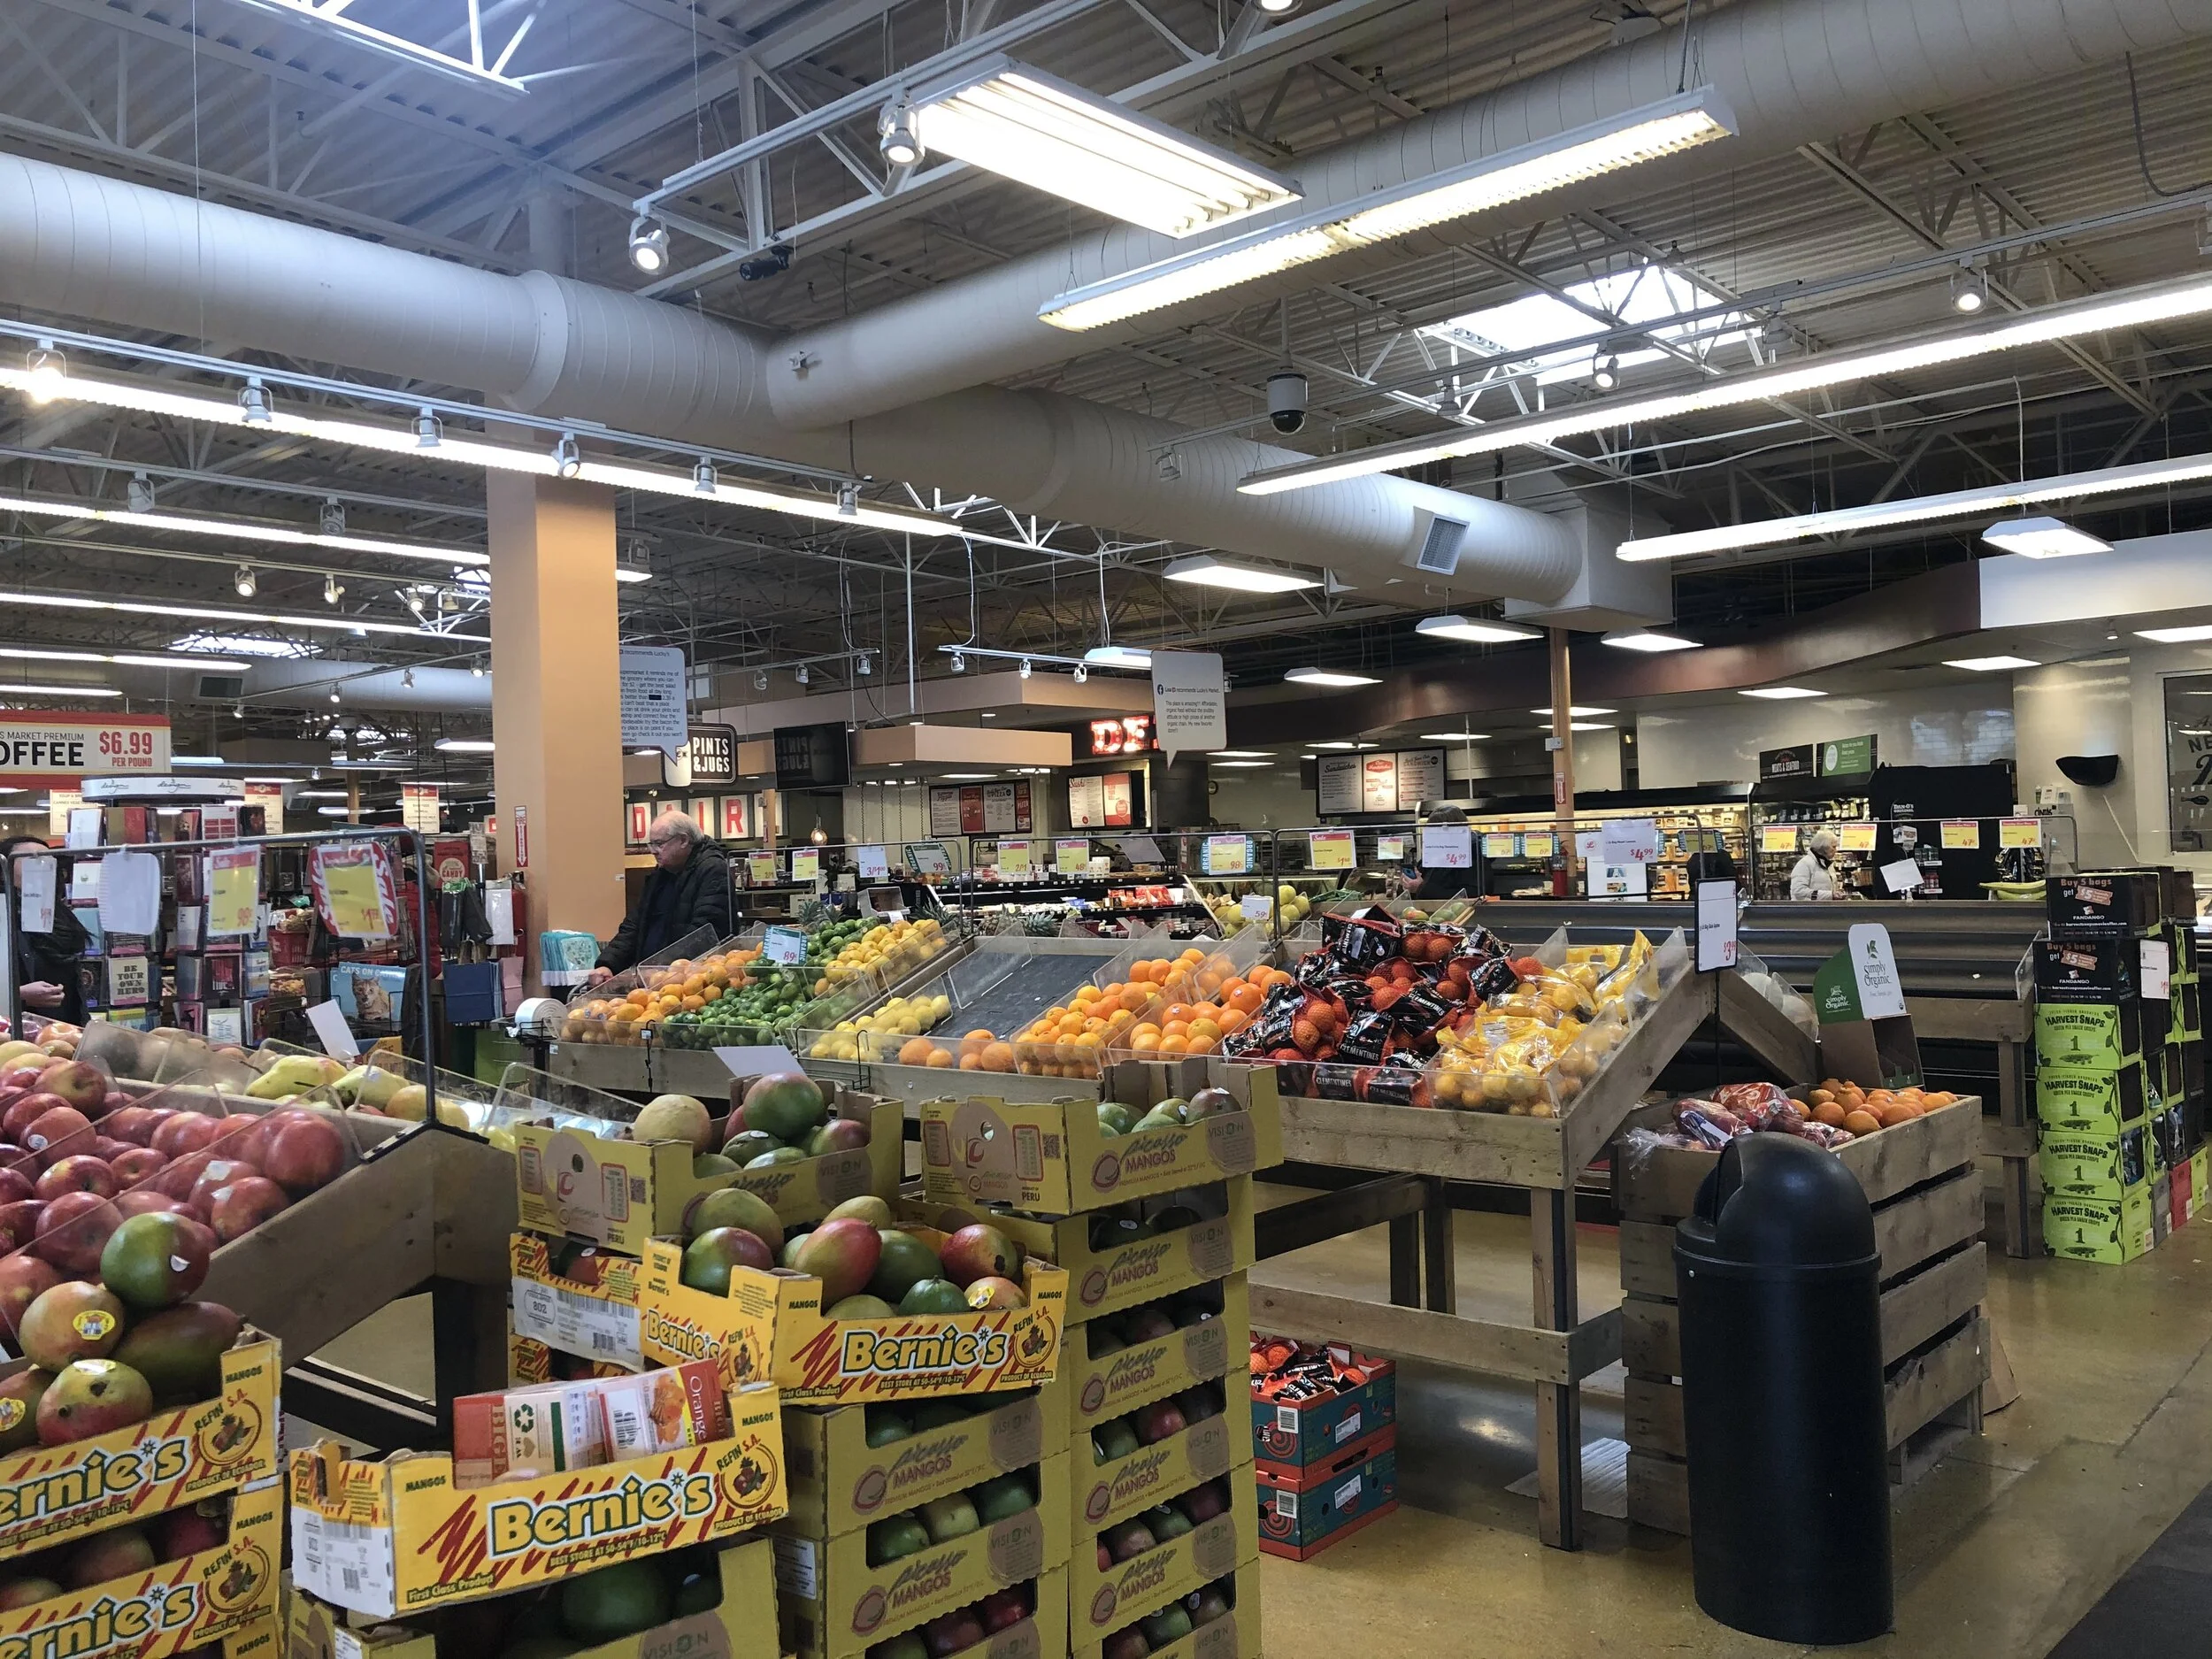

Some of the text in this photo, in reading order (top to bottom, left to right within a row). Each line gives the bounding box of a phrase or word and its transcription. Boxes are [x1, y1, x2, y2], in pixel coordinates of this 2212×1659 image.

[44, 732, 84, 741] PREMIUM
[99, 731, 152, 756] $6.99
[693, 737, 728, 756] PINTS
[111, 757, 152, 767] PER POUND
[2089, 879, 2112, 887] bags
[2080, 888, 2093, 899] $5
[2066, 953, 2078, 964] $5
[341, 966, 360, 975] CATS
[117, 987, 145, 995] HERO
[1408, 991, 1446, 1017] CLEMENTINES
[2045, 1015, 2105, 1027] HARVEST SNAPS
[2070, 1035, 2080, 1051] 1
[1340, 1044, 1379, 1062] CLEMENTINES
[1316, 1077, 1352, 1087] CLEMENTINES
[2045, 1080, 2103, 1094] HARVEST SNAPS
[2069, 1101, 2079, 1117] 1
[2049, 1144, 2108, 1158] HARVEST SNAPS
[1125, 1149, 1176, 1174] MANGOS
[2074, 1165, 2084, 1181] 1
[1021, 1192, 1041, 1202] PERU
[2051, 1206, 2109, 1222] HARVEST SNAPS
[2075, 1228, 2085, 1244] 1
[1111, 1259, 1159, 1286] MANGOS
[1038, 1291, 1063, 1300] MANGOS
[533, 1301, 547, 1314] 802
[788, 1300, 818, 1310] MANGOS
[1013, 1317, 1034, 1333] REFIN
[647, 1309, 721, 1364] Bernie's
[727, 1330, 744, 1346] REFIN
[842, 1325, 1006, 1373] Bernie's
[225, 1367, 263, 1382] MANGOS
[1001, 1374, 1022, 1383] PRODUCT
[1030, 1371, 1052, 1380] ECUADOR
[1110, 1364, 1155, 1394] MANGOS
[880, 1379, 893, 1389] BEST
[894, 1378, 912, 1388] STORE
[913, 1377, 920, 1386] AT
[780, 1386, 841, 1400] First Class Product
[689, 1374, 709, 1440] Orange
[193, 1402, 225, 1432] REFIN
[741, 1411, 774, 1426] MANGOS
[718, 1445, 743, 1471] REFIN
[186, 1459, 266, 1492] PRODUCT OF ECUADOR
[893, 1455, 953, 1489] MANGOS
[405, 1475, 446, 1493] MANGOS
[1115, 1468, 1159, 1501] MANGOS
[236, 1511, 273, 1530] MANGOS
[491, 1474, 713, 1557] Bernie's
[715, 1508, 784, 1532] PRODUCT OF ECUADOR
[203, 1550, 233, 1579] REFIN
[549, 1548, 604, 1567] BEST STORE AT
[407, 1571, 495, 1603] First Class Product
[892, 1571, 952, 1609] MANGOS
[1120, 1569, 1165, 1602] MANGOS
[194, 1606, 272, 1640] PRODUCT OF ECUADOR
[236, 1634, 271, 1655] MANGOS
